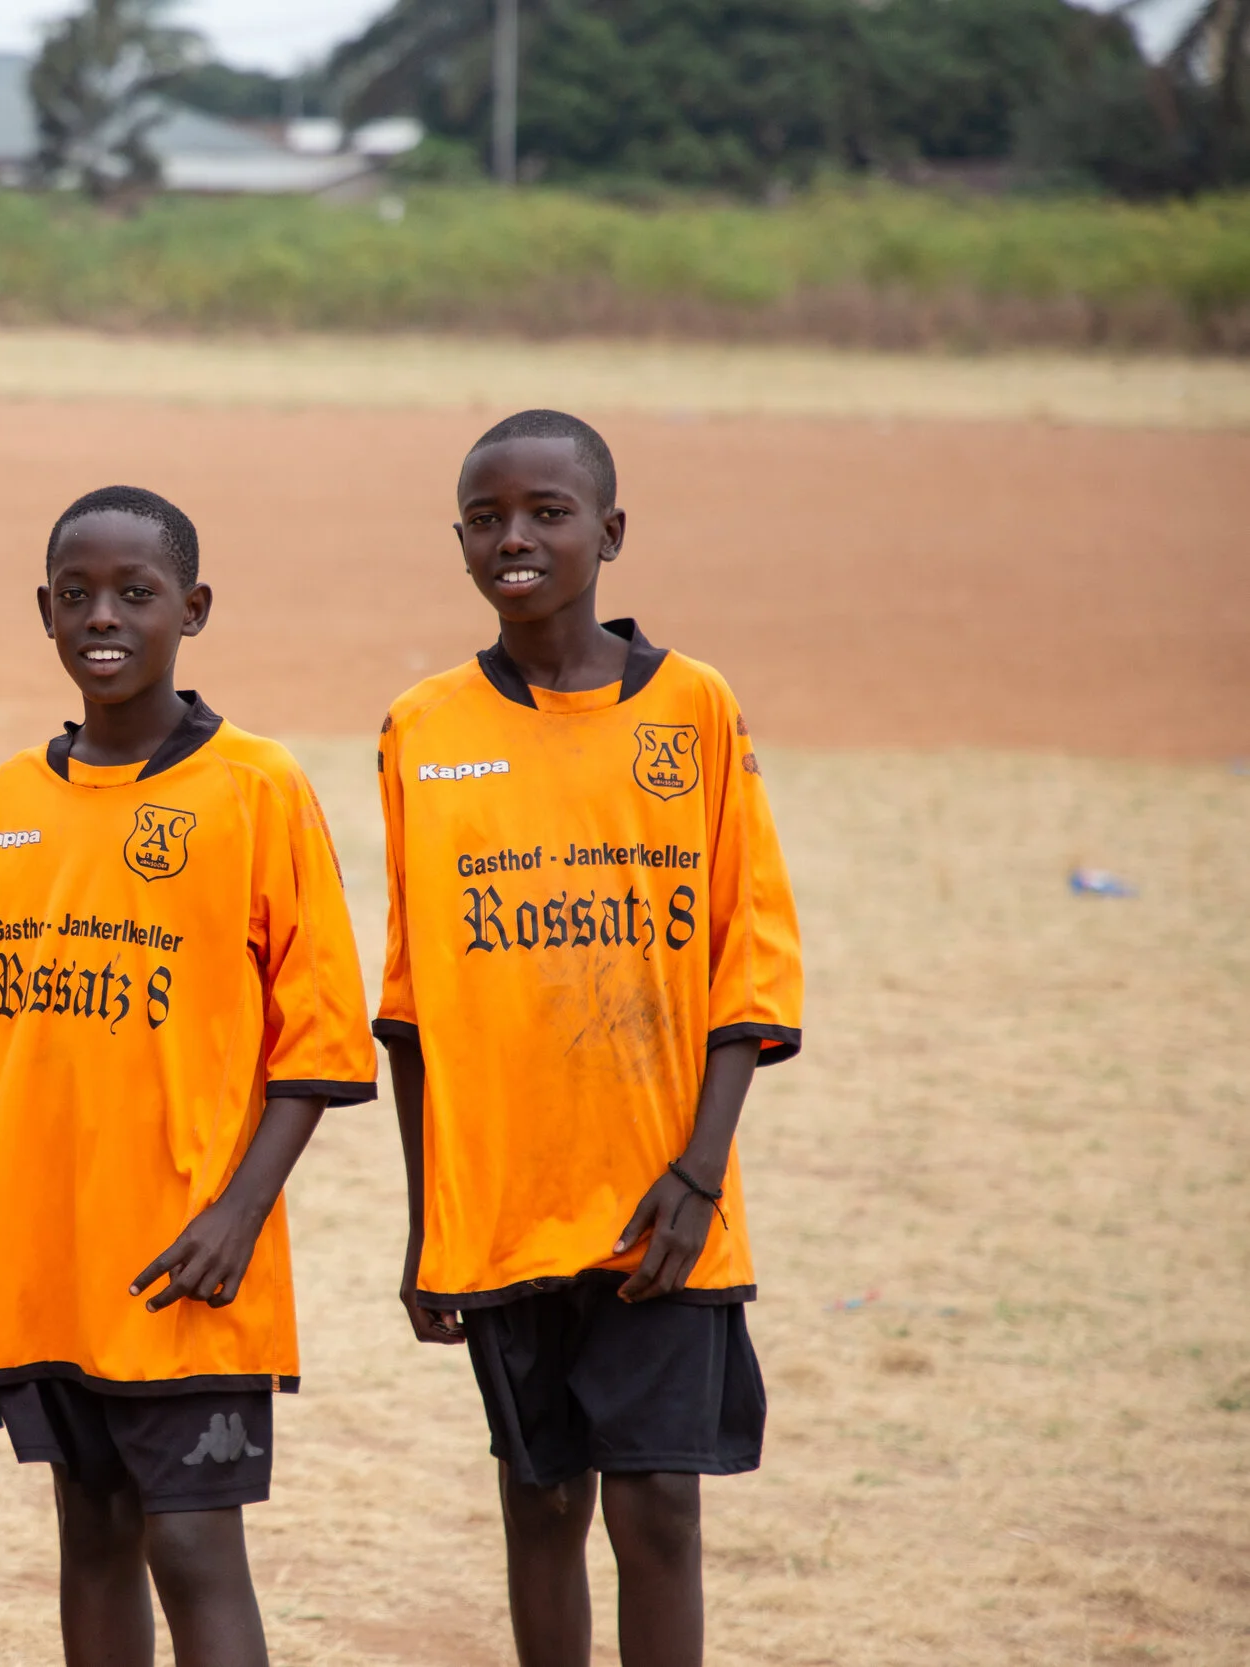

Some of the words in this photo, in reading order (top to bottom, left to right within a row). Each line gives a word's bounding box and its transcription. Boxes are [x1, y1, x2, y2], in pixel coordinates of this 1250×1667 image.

[419, 759, 510, 781] Kappa
[456, 846, 542, 877] Gasthof
[58, 913, 183, 952] Jankerlkeller
[463, 885, 656, 960] Rossatz
[666, 885, 696, 951] 8
[147, 965, 172, 1030] 8
